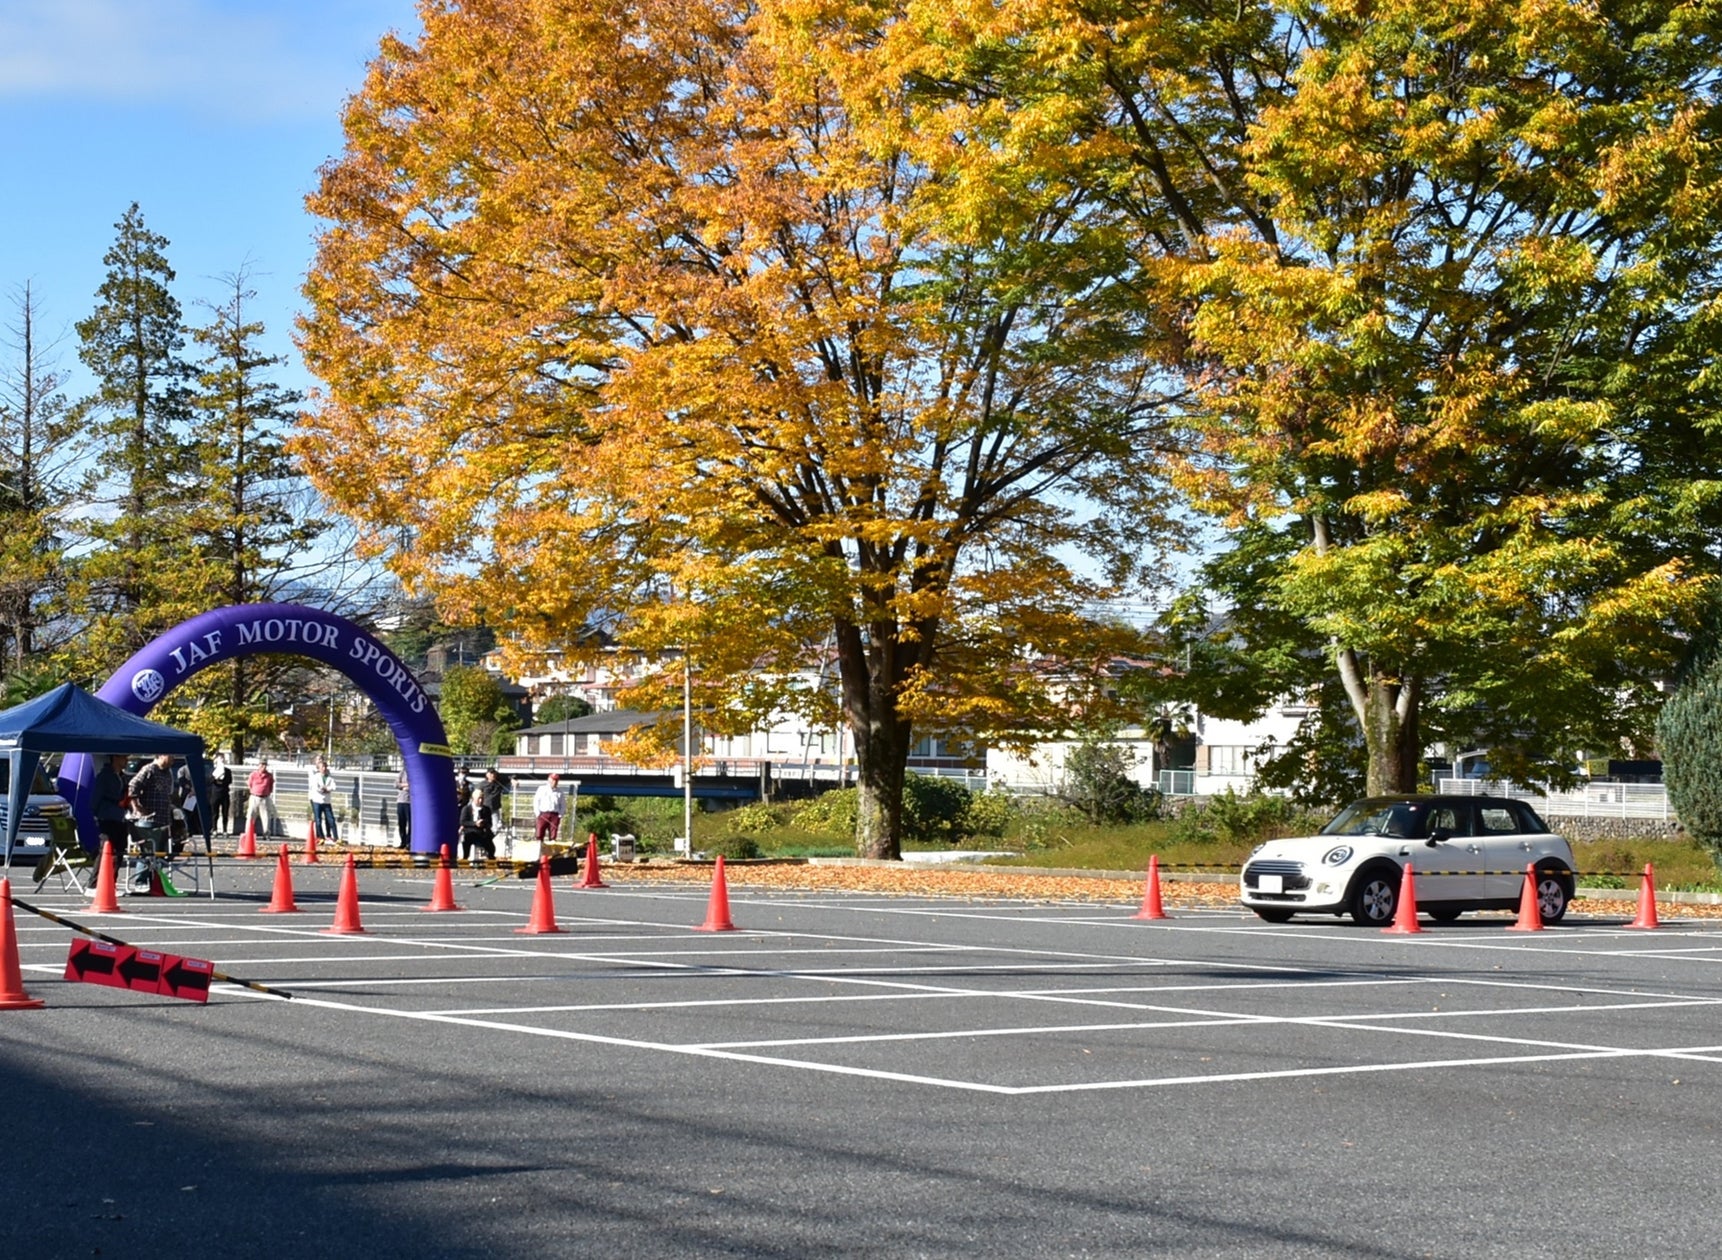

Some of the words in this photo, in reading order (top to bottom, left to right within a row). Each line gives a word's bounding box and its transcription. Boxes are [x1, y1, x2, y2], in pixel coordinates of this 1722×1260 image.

[169, 630, 223, 674] JAF
[236, 618, 340, 649] MOTOR
[348, 636, 428, 714] SPORTS
